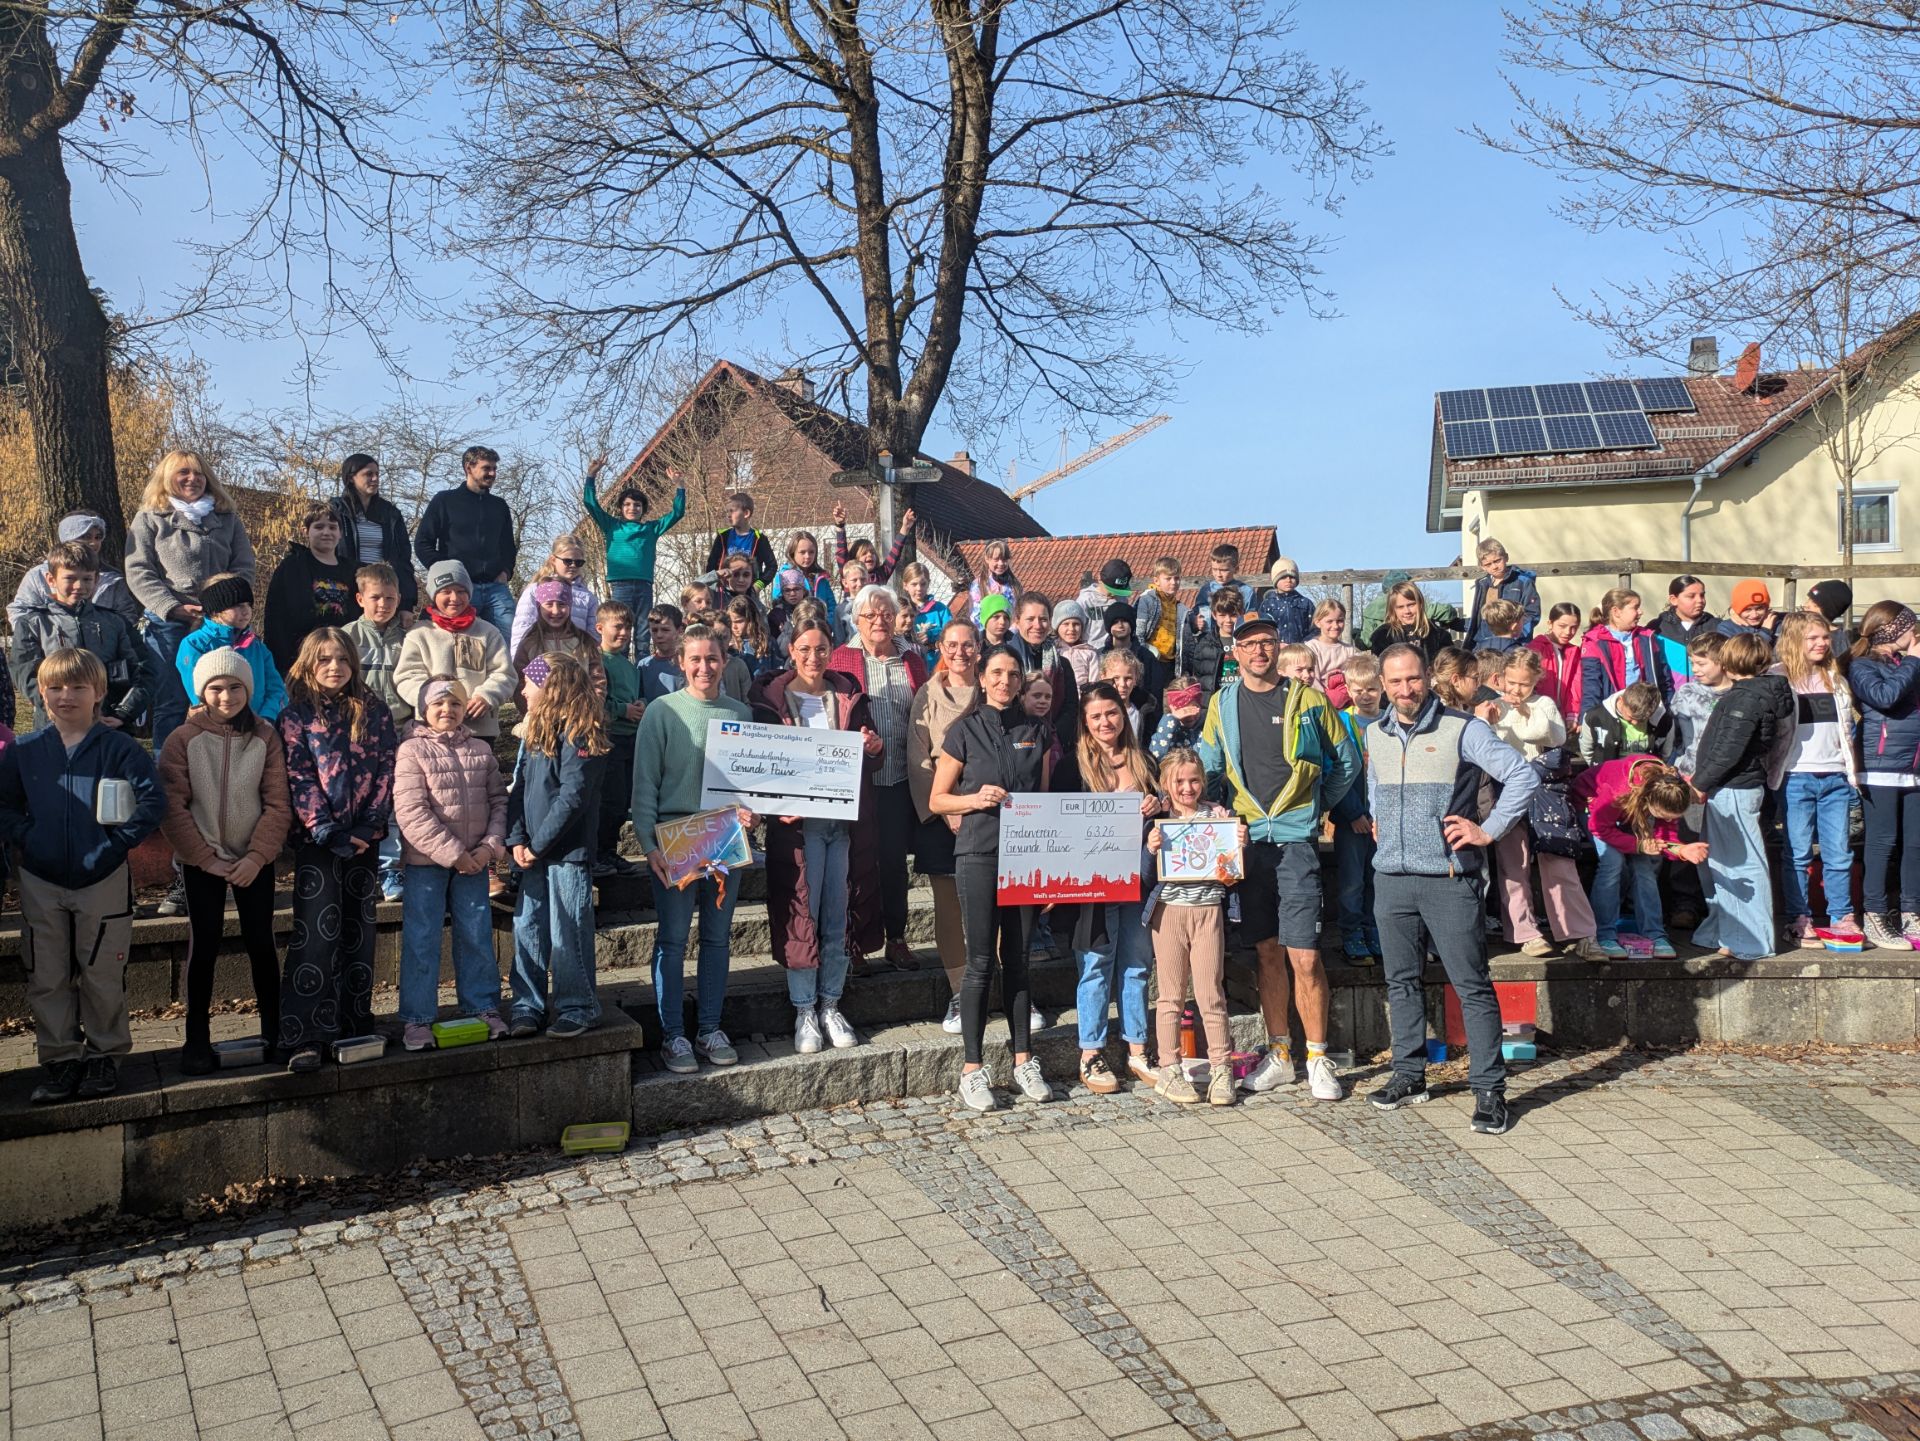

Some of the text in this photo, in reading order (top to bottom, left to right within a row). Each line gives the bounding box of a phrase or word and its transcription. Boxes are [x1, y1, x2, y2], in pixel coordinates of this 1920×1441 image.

[731, 760, 799, 776] Gesunde Pause
[1005, 840, 1041, 853] Gesunde
[1046, 839, 1073, 853] Pause
